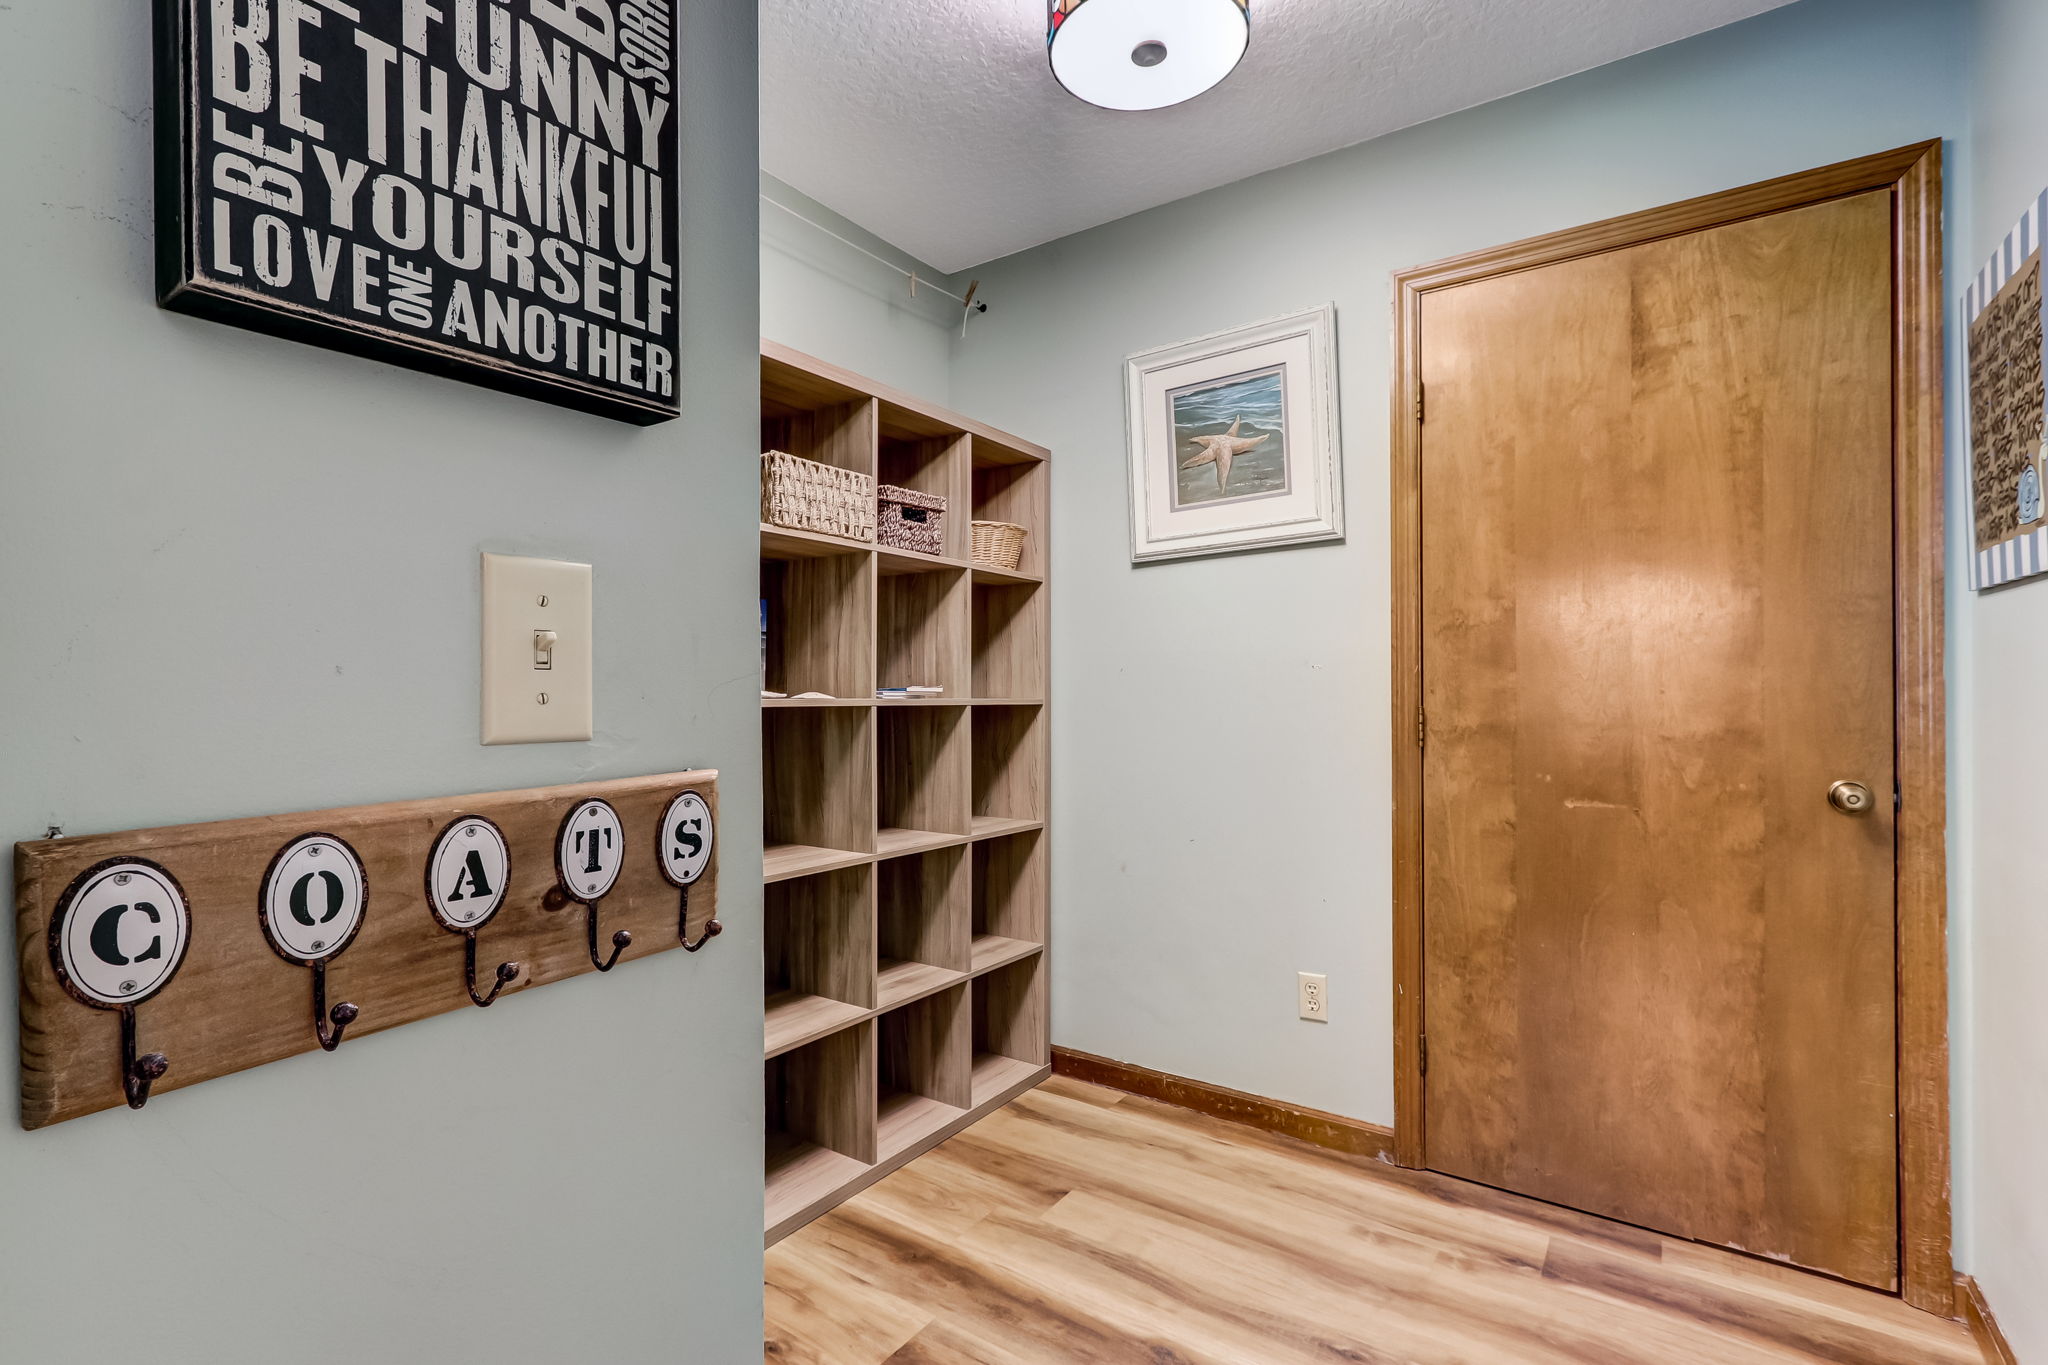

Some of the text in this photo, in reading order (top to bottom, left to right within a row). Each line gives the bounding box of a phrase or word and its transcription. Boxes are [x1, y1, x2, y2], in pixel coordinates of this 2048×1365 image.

[211, 0, 672, 278] BE THANKFUL
[213, 108, 672, 335] BE YOURSELF
[214, 197, 672, 396] LOVE ONE ANOTHER
[90, 817, 702, 966] COATS
